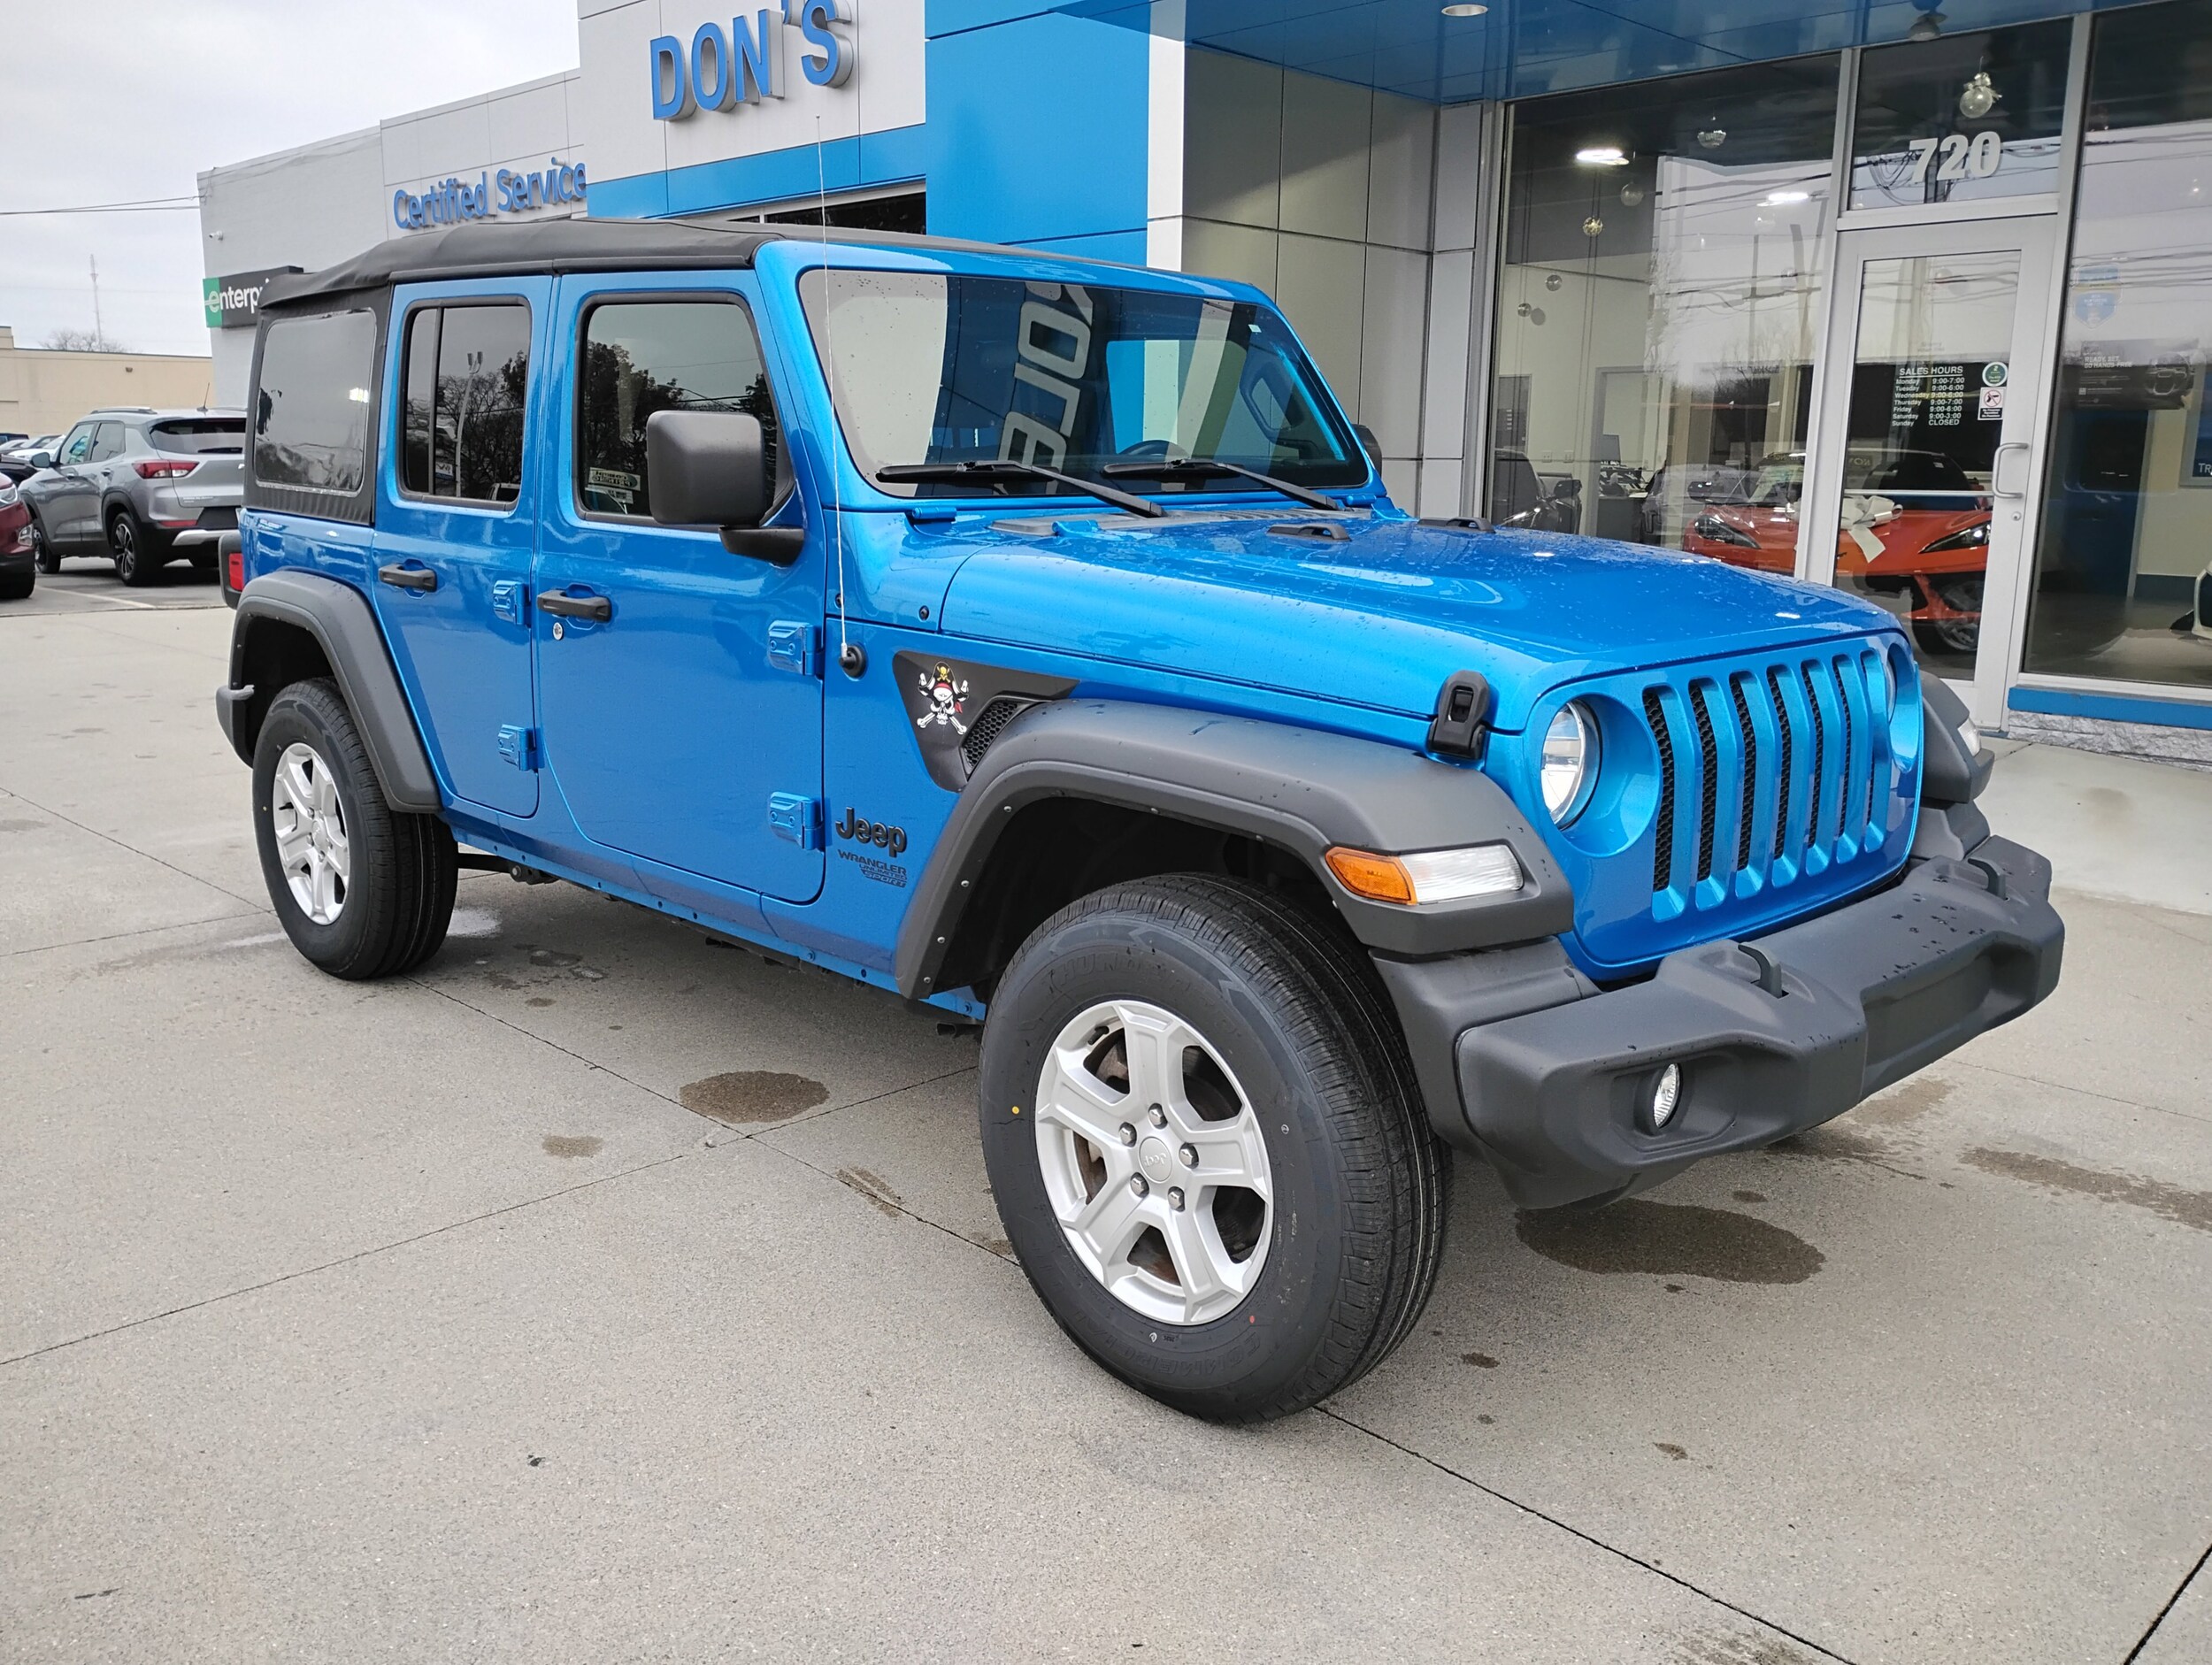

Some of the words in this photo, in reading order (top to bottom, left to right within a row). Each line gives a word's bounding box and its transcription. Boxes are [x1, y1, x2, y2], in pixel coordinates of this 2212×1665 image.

[649, 0, 839, 120] DON'S
[1909, 131, 2001, 183] 720
[393, 171, 488, 230] Certified
[496, 157, 587, 212] Service
[1899, 367, 1929, 376] SALES
[1931, 365, 1963, 375] HOURS
[834, 806, 907, 858] Jeep
[837, 848, 907, 876] WRANGLER
[858, 863, 908, 881] UNLIMITED
[863, 871, 907, 887] SPORT
